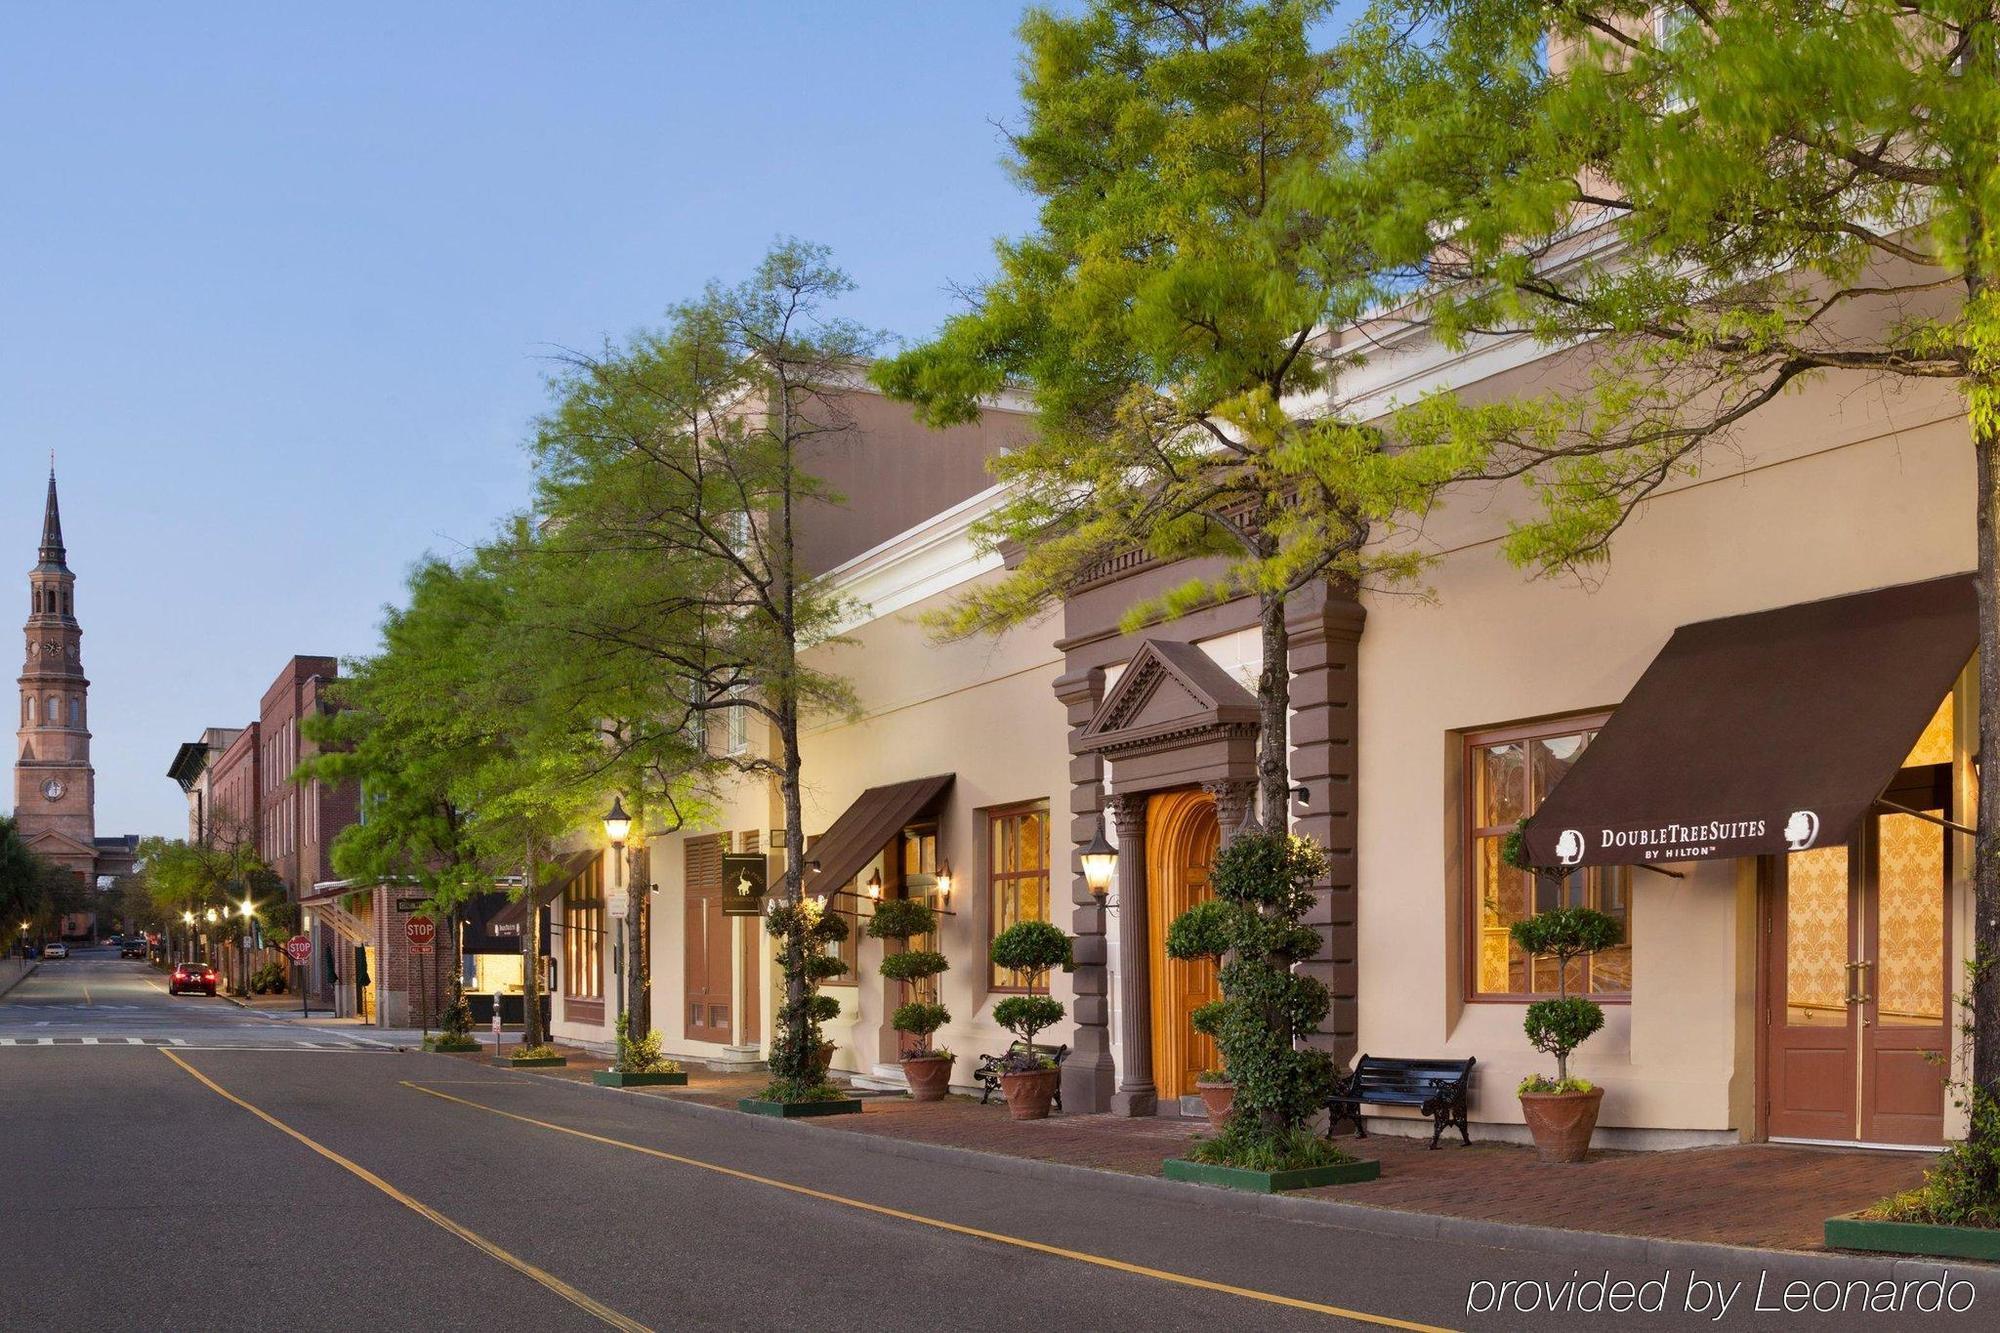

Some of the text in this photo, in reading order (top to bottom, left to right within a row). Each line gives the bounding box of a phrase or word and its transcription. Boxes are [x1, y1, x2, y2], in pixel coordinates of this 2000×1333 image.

[1645, 850, 1659, 859] BY
[407, 924, 433, 936] STOP
[290, 942, 311, 952] STOP
